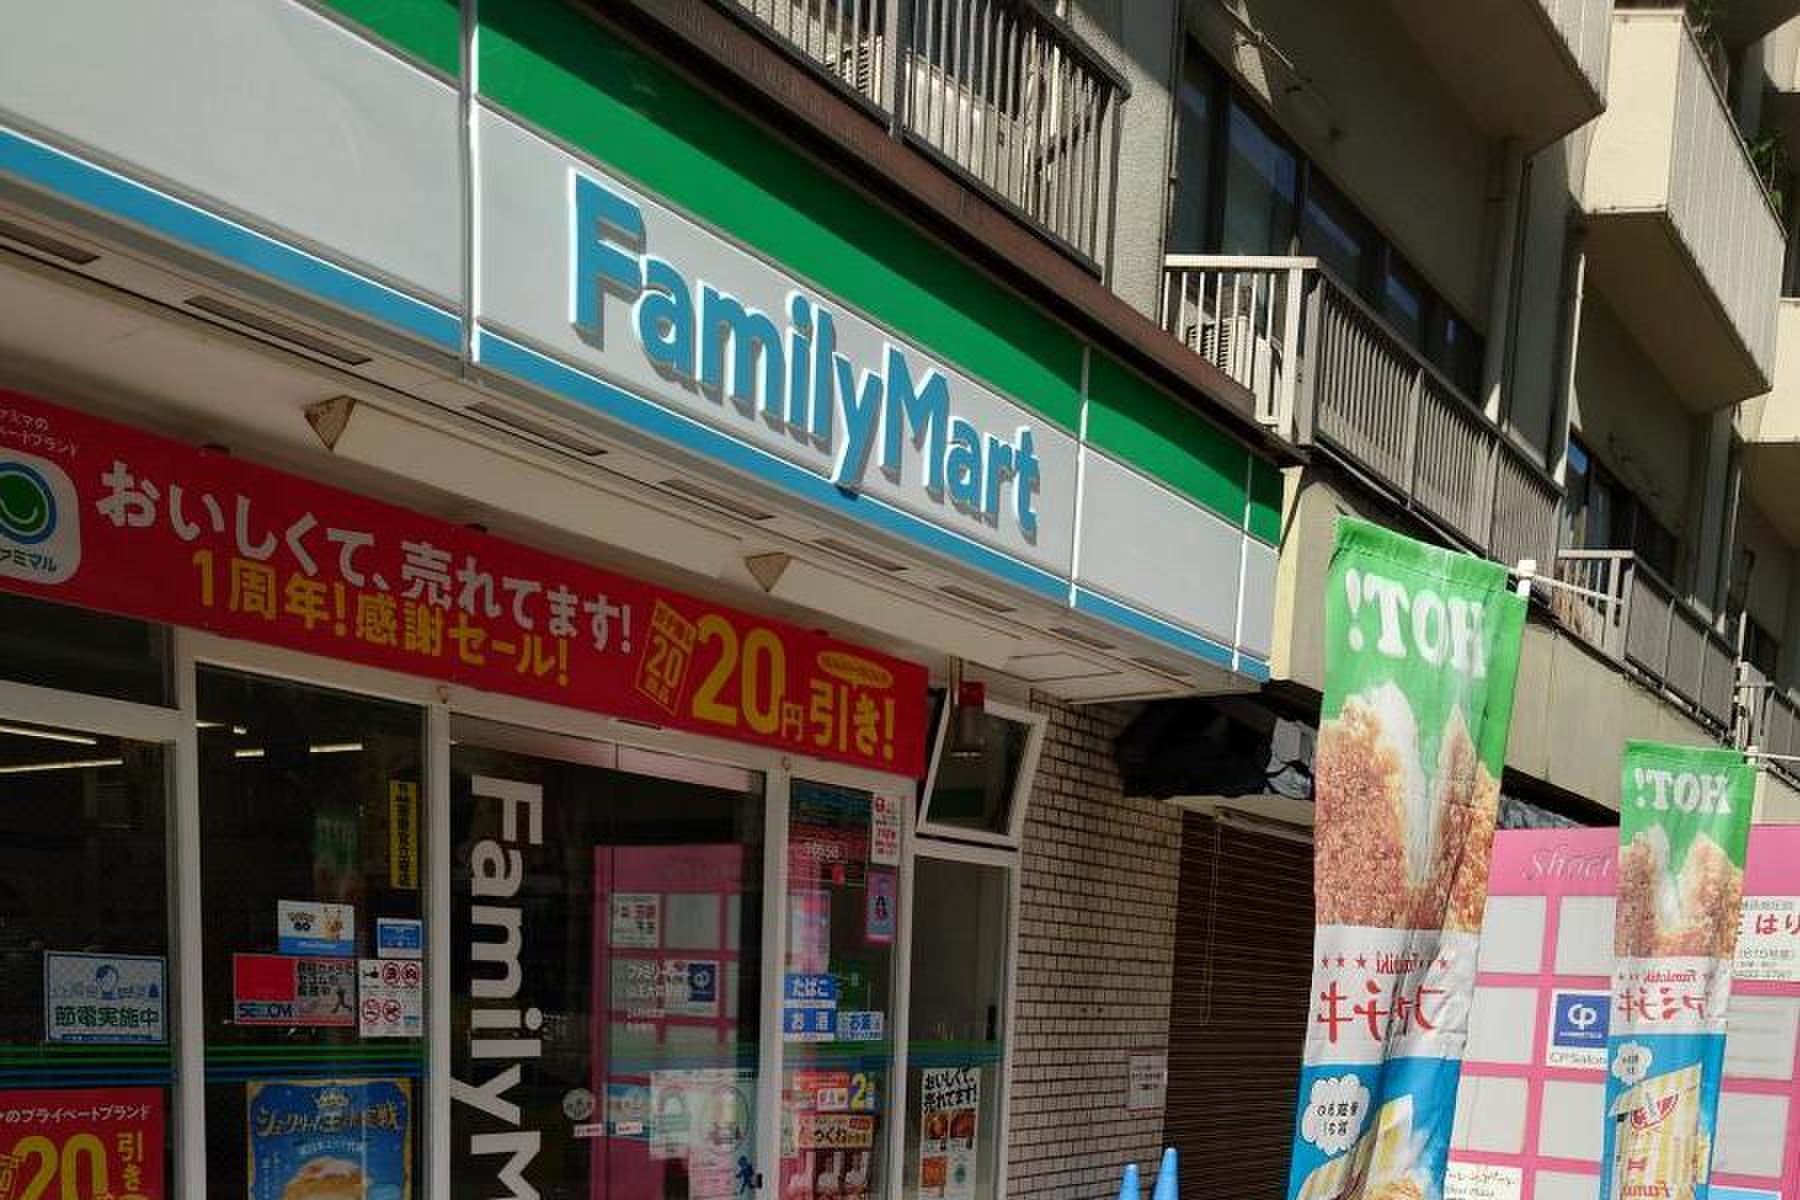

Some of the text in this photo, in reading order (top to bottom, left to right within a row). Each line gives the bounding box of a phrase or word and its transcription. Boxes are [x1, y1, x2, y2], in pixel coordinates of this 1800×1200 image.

[569, 167, 1040, 544] FamilyMart
[0, 1103, 149, 1122] のプライベートブランド
